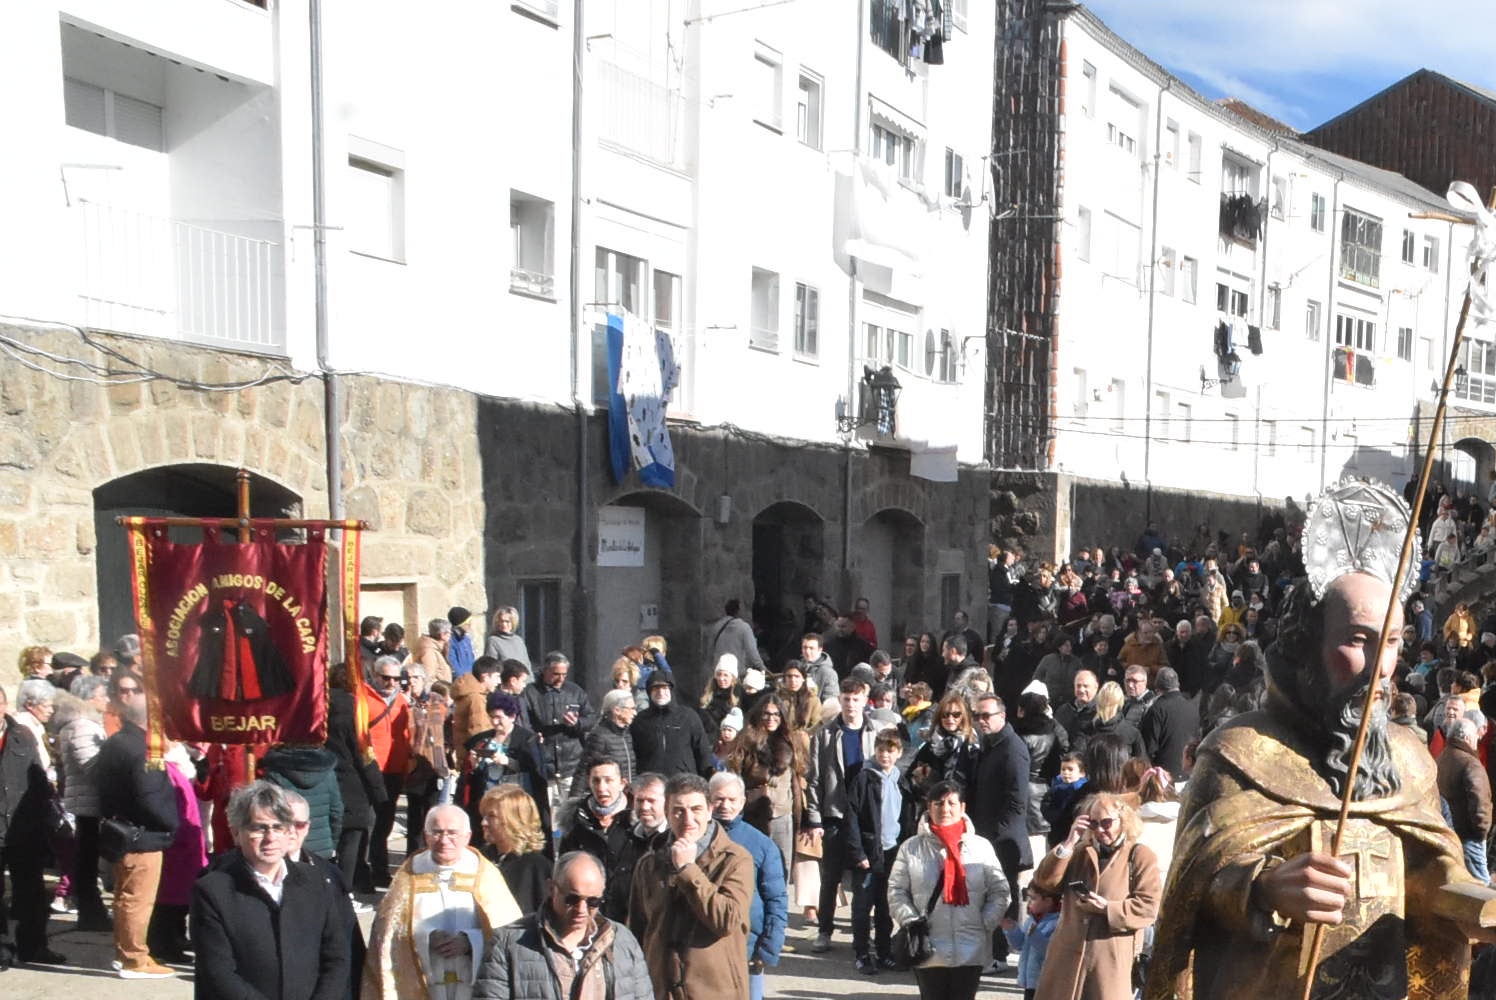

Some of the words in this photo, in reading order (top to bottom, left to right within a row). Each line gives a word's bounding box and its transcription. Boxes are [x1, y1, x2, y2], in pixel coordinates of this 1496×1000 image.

[165, 582, 209, 658] ASOCIACION
[212, 574, 264, 589] AMIGOS
[265, 581, 286, 601] DE
[282, 596, 302, 617] LA
[295, 617, 316, 655] CAPA
[210, 715, 277, 731] BEJAR
